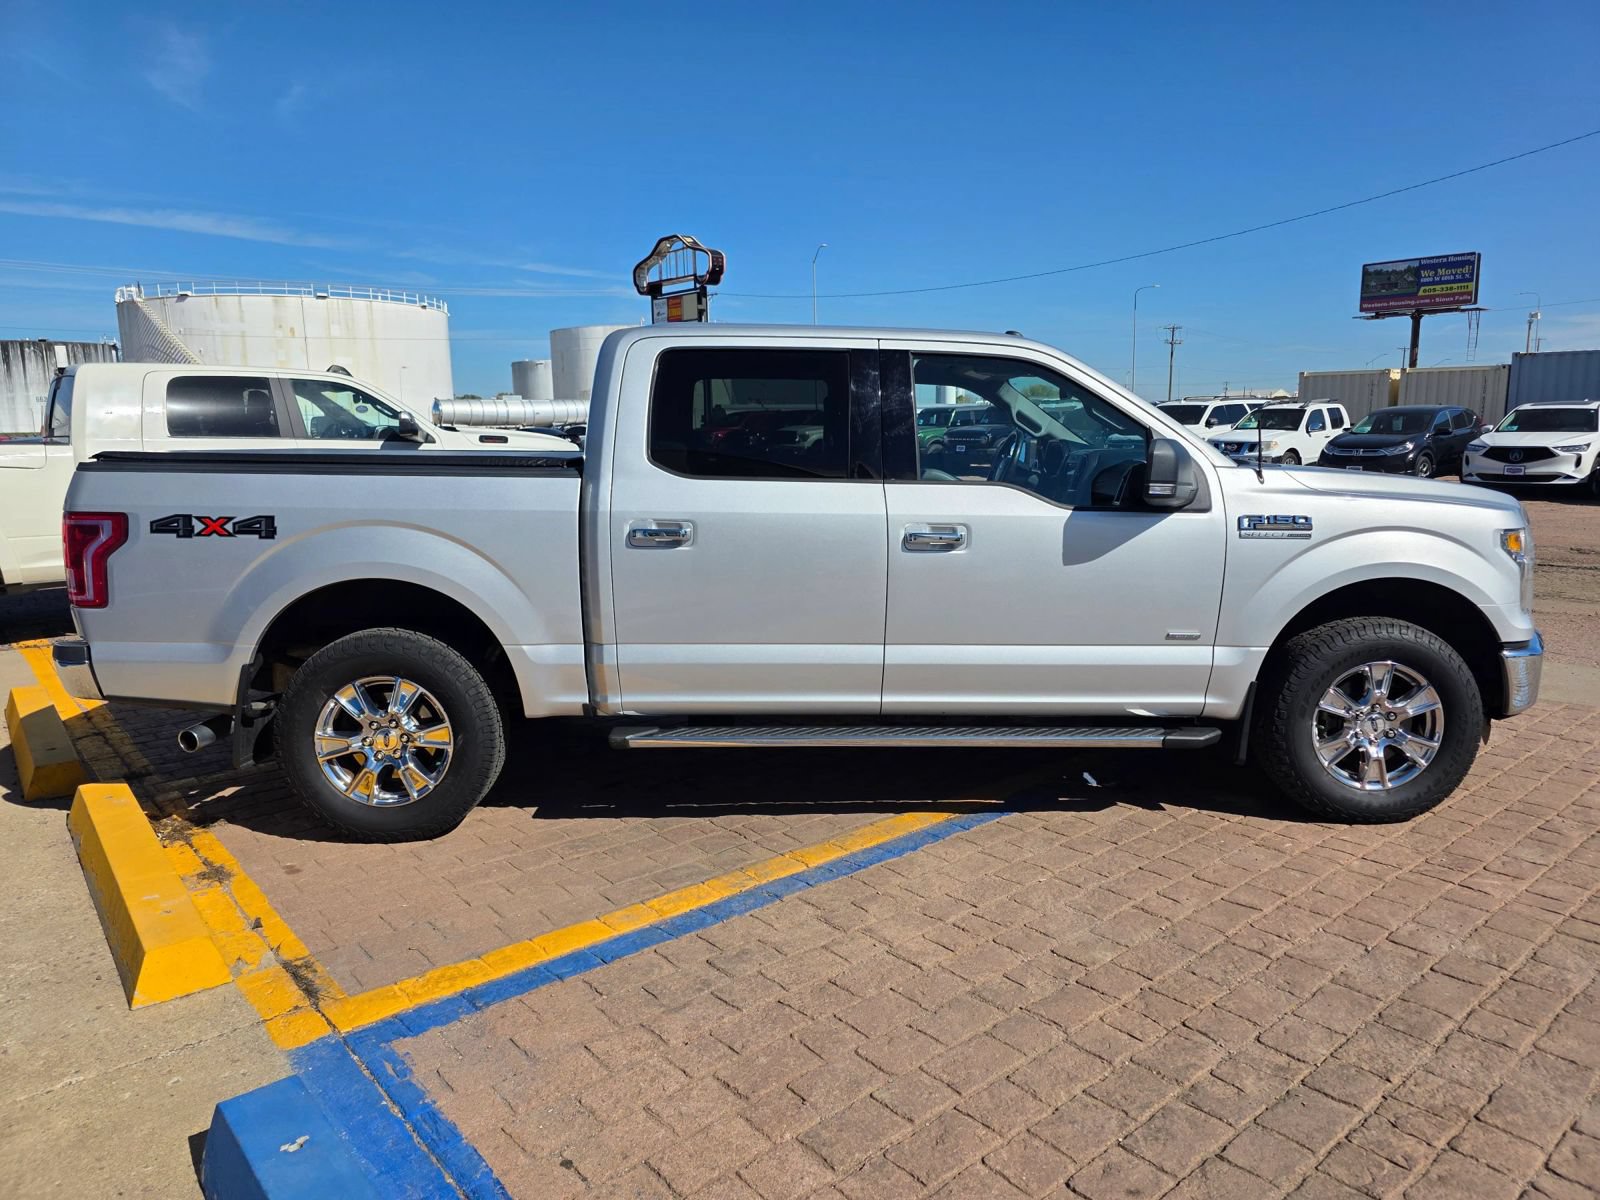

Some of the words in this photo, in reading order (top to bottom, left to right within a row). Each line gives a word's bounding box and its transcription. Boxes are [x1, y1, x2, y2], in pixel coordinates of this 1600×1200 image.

[1421, 257, 1447, 265] Western
[1448, 254, 1476, 262] Housing
[1438, 266, 1472, 276] Moved!
[1423, 285, 1469, 293] 605-338-1111
